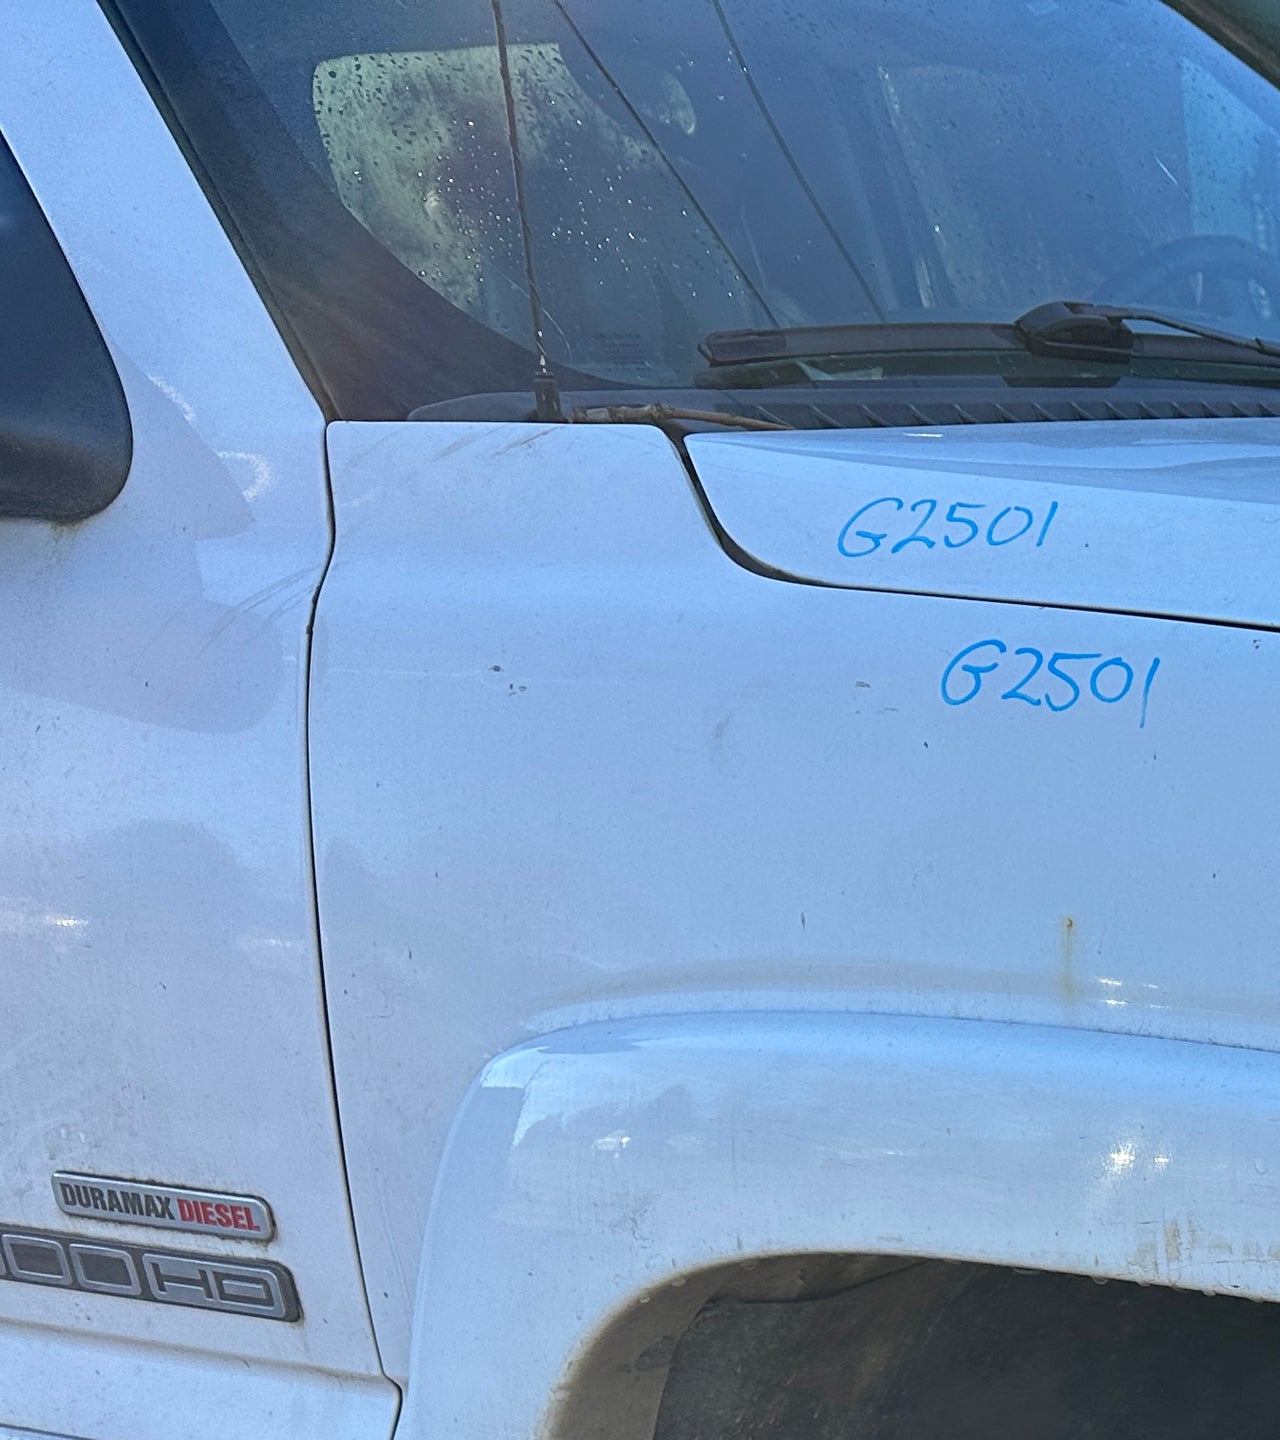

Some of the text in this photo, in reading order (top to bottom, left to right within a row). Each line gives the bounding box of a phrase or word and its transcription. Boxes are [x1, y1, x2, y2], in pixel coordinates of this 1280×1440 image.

[837, 497, 1058, 557] G2501
[941, 639, 1160, 728] G2501
[59, 1182, 262, 1232] DURAMAX DIESEL
[0, 1233, 288, 1318] 00HD
